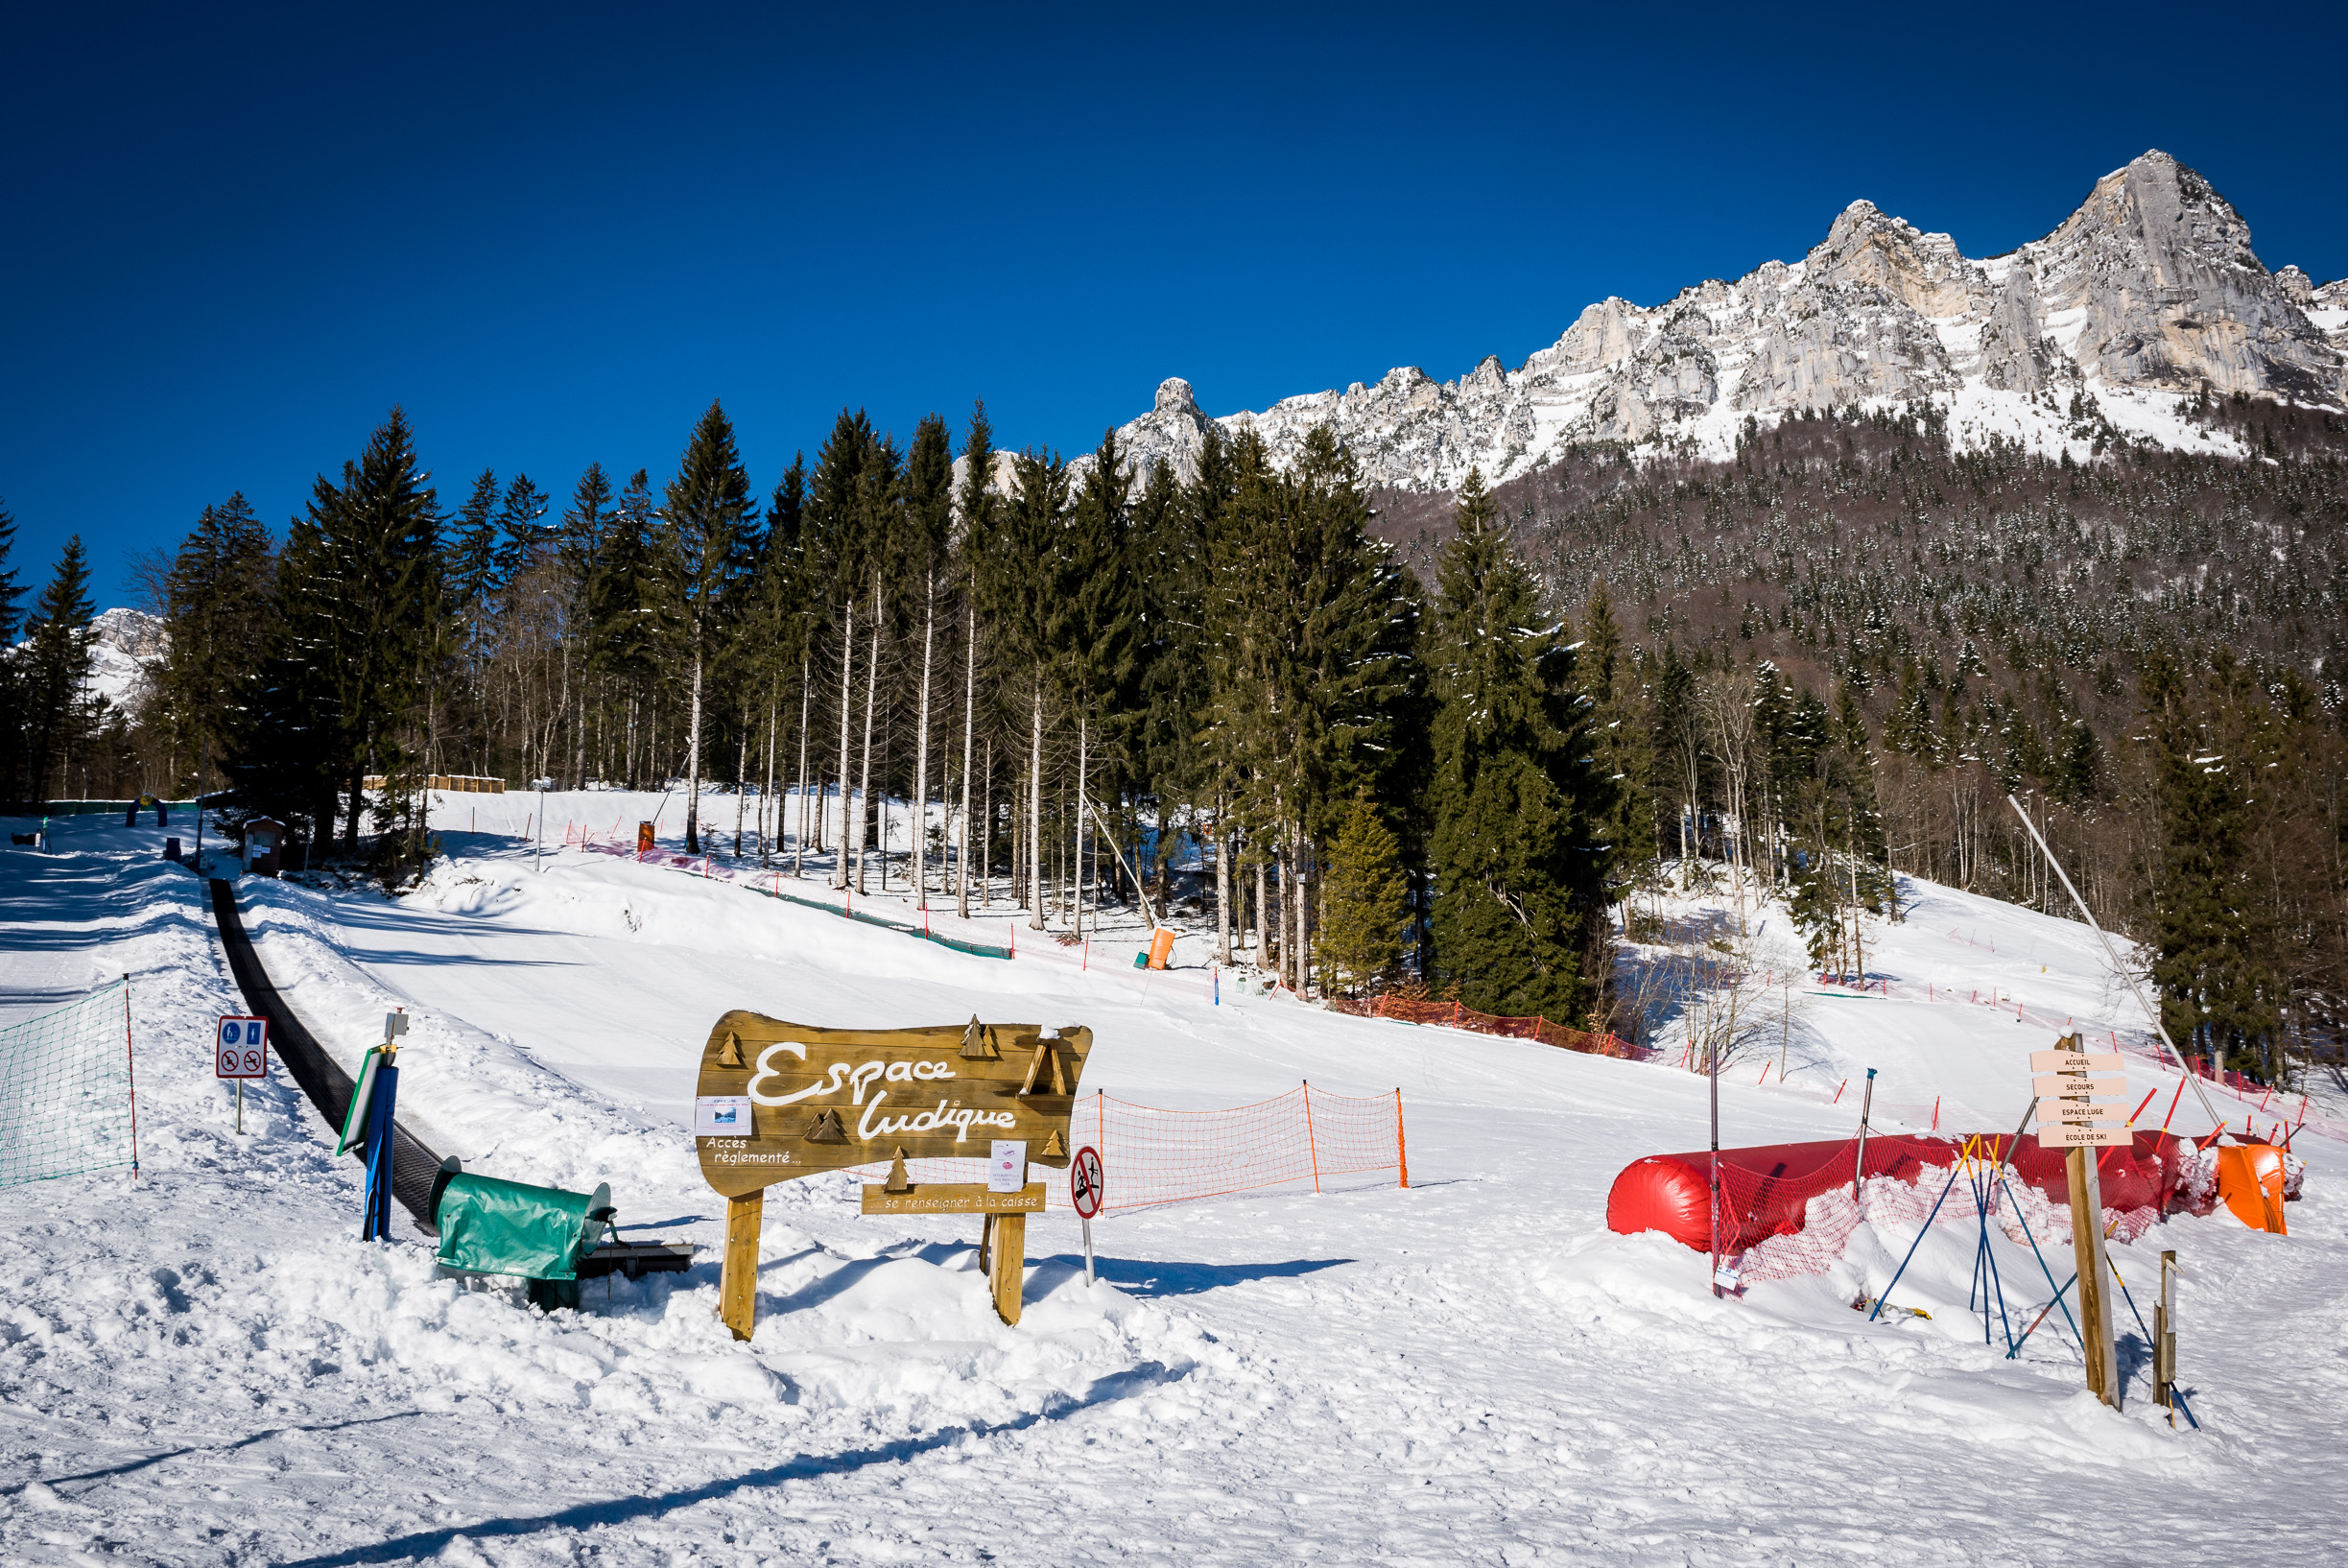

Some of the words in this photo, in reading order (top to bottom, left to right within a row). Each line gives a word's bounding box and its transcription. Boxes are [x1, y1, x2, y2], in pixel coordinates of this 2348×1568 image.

[747, 1041, 957, 1106] Espace
[706, 1135, 747, 1149] Accès
[2065, 1132, 2085, 1141] ÉCOLE
[905, 1197, 970, 1211] renseigner
[975, 1196, 983, 1207] à
[985, 1196, 996, 1207] la
[1001, 1197, 1037, 1207] caisse
